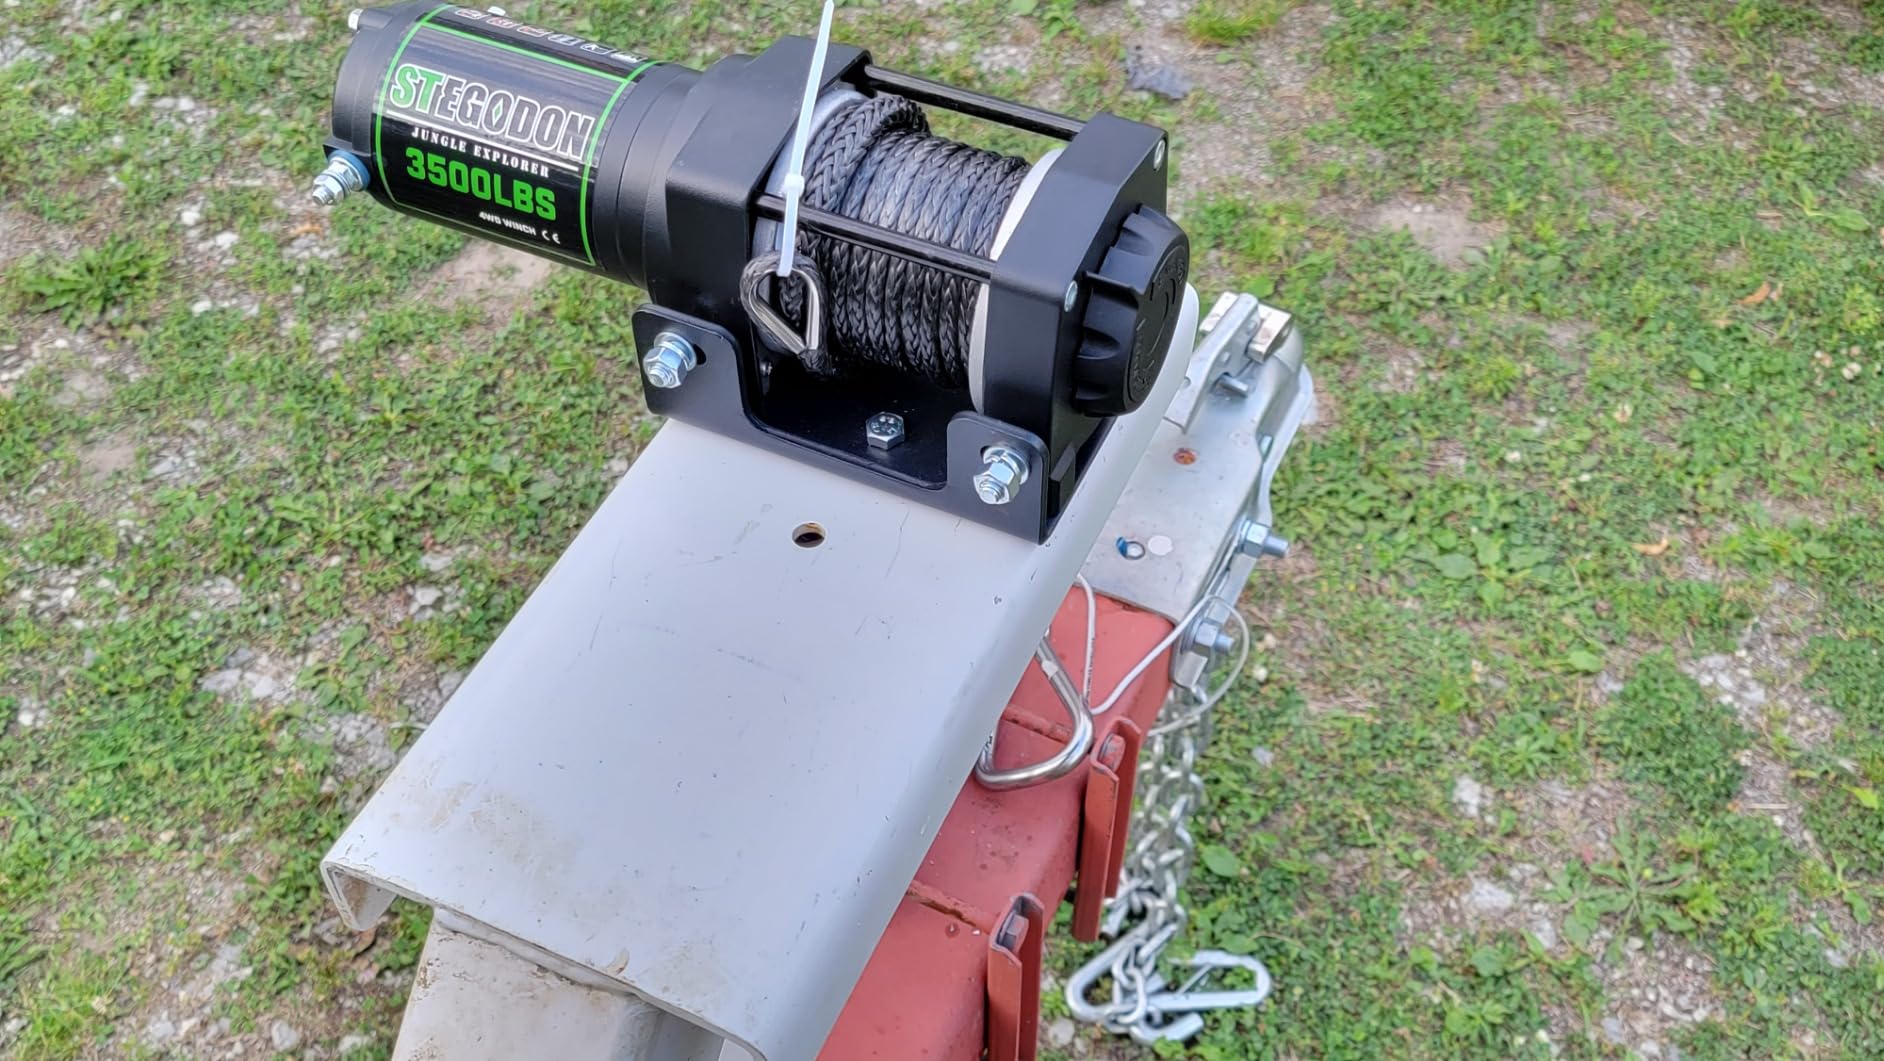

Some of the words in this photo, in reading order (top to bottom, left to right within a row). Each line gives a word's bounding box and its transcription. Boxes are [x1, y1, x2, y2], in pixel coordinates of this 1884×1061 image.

[389, 63, 596, 159] STEGODON
[411, 127, 467, 153] JUNGLE
[474, 145, 550, 178] EXPLORER
[405, 147, 556, 221] 3500LBS
[479, 211, 502, 225] 4WD
[502, 217, 537, 237] WINCH
